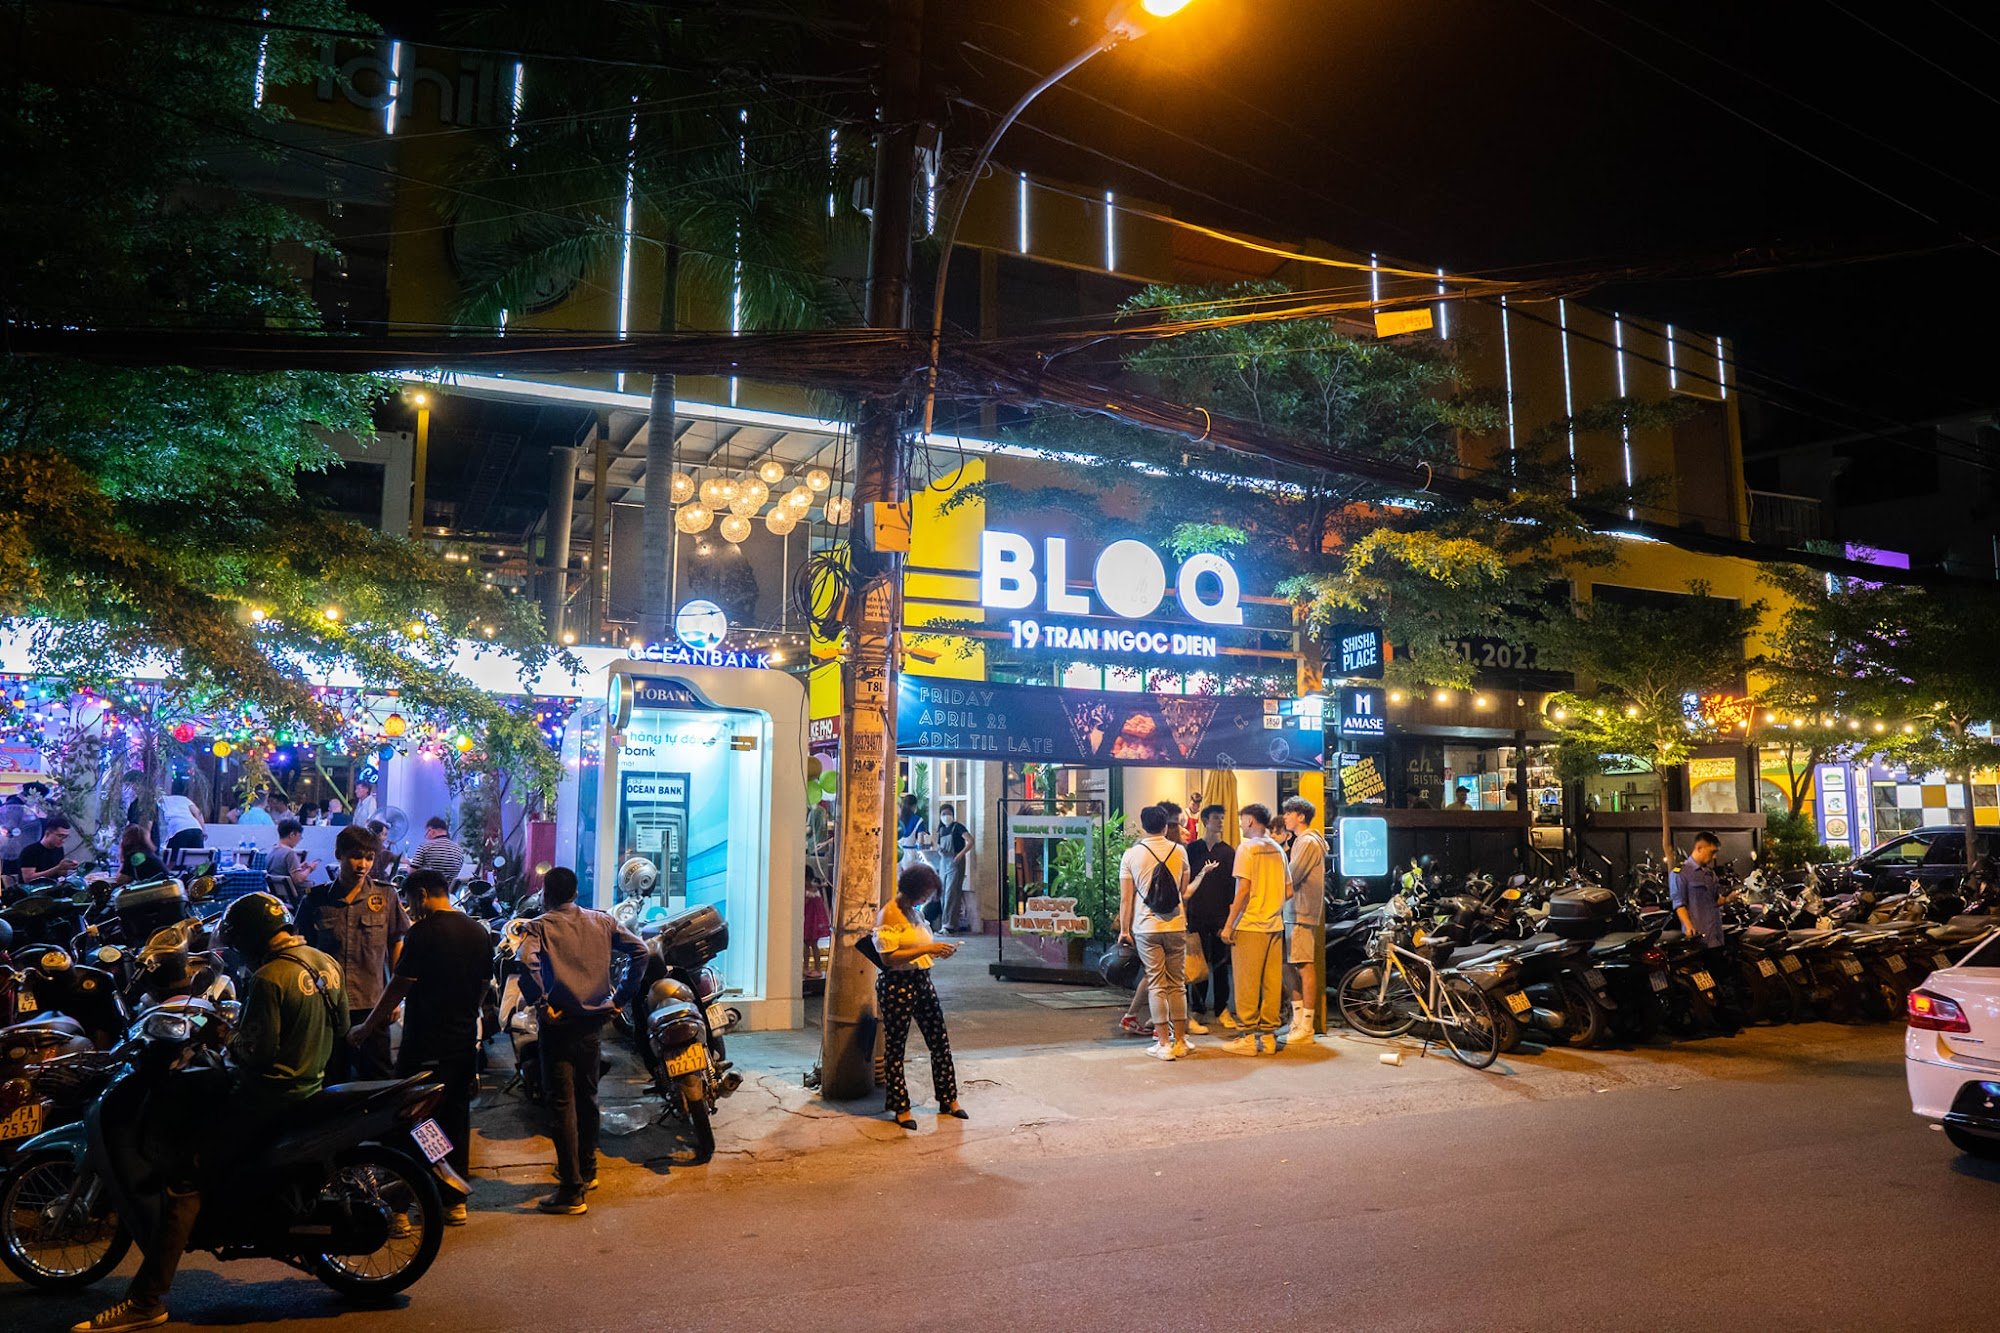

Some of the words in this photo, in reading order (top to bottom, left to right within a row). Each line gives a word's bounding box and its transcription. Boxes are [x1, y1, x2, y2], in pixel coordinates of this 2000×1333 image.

[981, 530, 1243, 625] BLOQ
[1009, 620, 1039, 649] 19
[1044, 625, 1099, 650] TRAN
[1102, 628, 1168, 654] NGOC
[1171, 634, 1216, 657] DIEN
[1342, 632, 1376, 654] SHISHA
[627, 642, 770, 670] OCEANBANK
[1343, 647, 1377, 672] PLACE
[920, 686, 994, 706] FRIDAY
[919, 709, 978, 728] APRIL
[986, 713, 1007, 730] 22
[1344, 717, 1384, 730] AMASE
[624, 746, 656, 757] bank
[918, 731, 960, 749] 6PM
[969, 733, 998, 751] TIL
[1008, 736, 1053, 754] LATE
[1343, 766, 1376, 787] HOTDOG
[627, 784, 656, 794] OCEAN
[658, 786, 682, 795] BANK
[1013, 918, 1053, 931] HAVE
